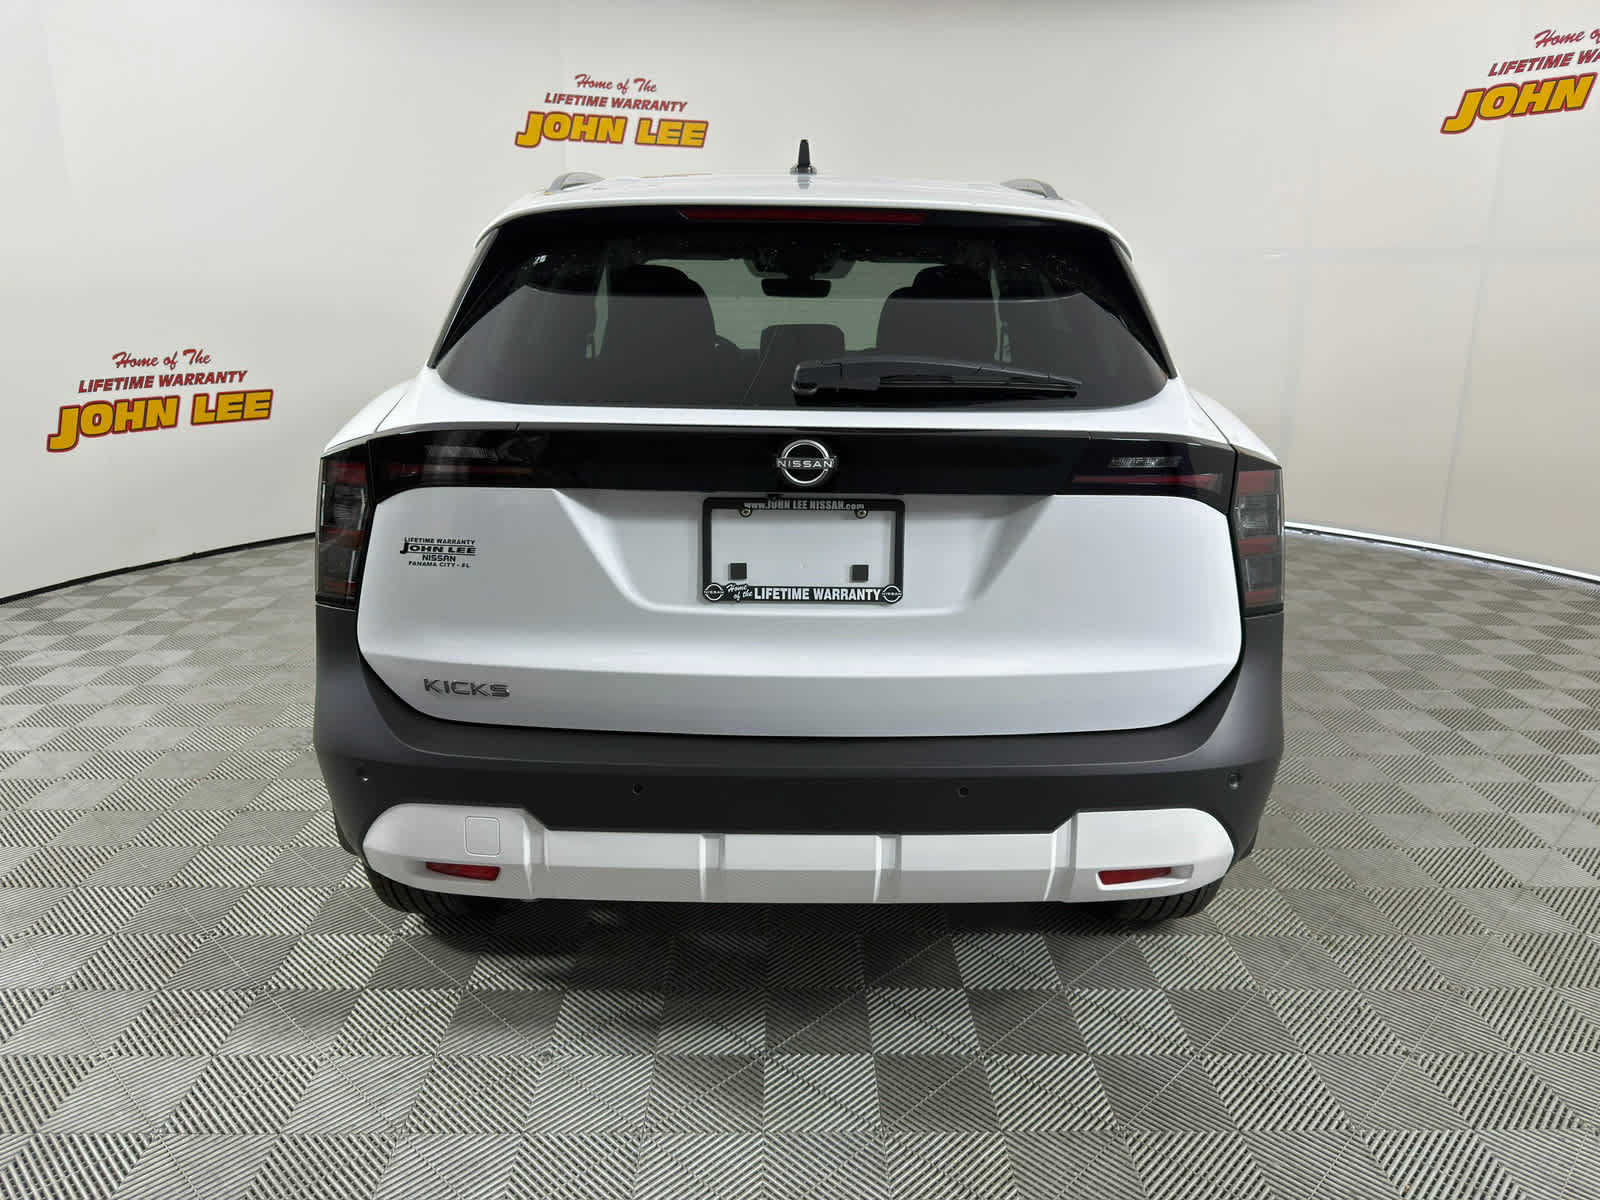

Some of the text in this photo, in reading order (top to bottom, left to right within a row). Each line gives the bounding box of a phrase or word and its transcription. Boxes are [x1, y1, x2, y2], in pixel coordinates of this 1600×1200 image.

[1534, 29, 1585, 48] Home
[1487, 52, 1575, 77] LIFETIME
[574, 73, 657, 95] Home of The
[544, 92, 688, 112] LIFETIME WARRANTY
[1439, 72, 1598, 135] JOHN
[514, 111, 709, 148] JOHN LEE
[112, 348, 211, 370] Home of The
[78, 370, 248, 394] LIFETIME WARRANTY
[46, 389, 274, 453] JOHN LEE
[776, 460, 833, 468] NISSAN
[793, 500, 808, 509] LEE
[400, 542, 476, 554] JOHN LEE
[422, 554, 456, 562] NISSAN
[754, 587, 881, 601] LIFETIME WARRANTY
[423, 678, 510, 697] KICKS
